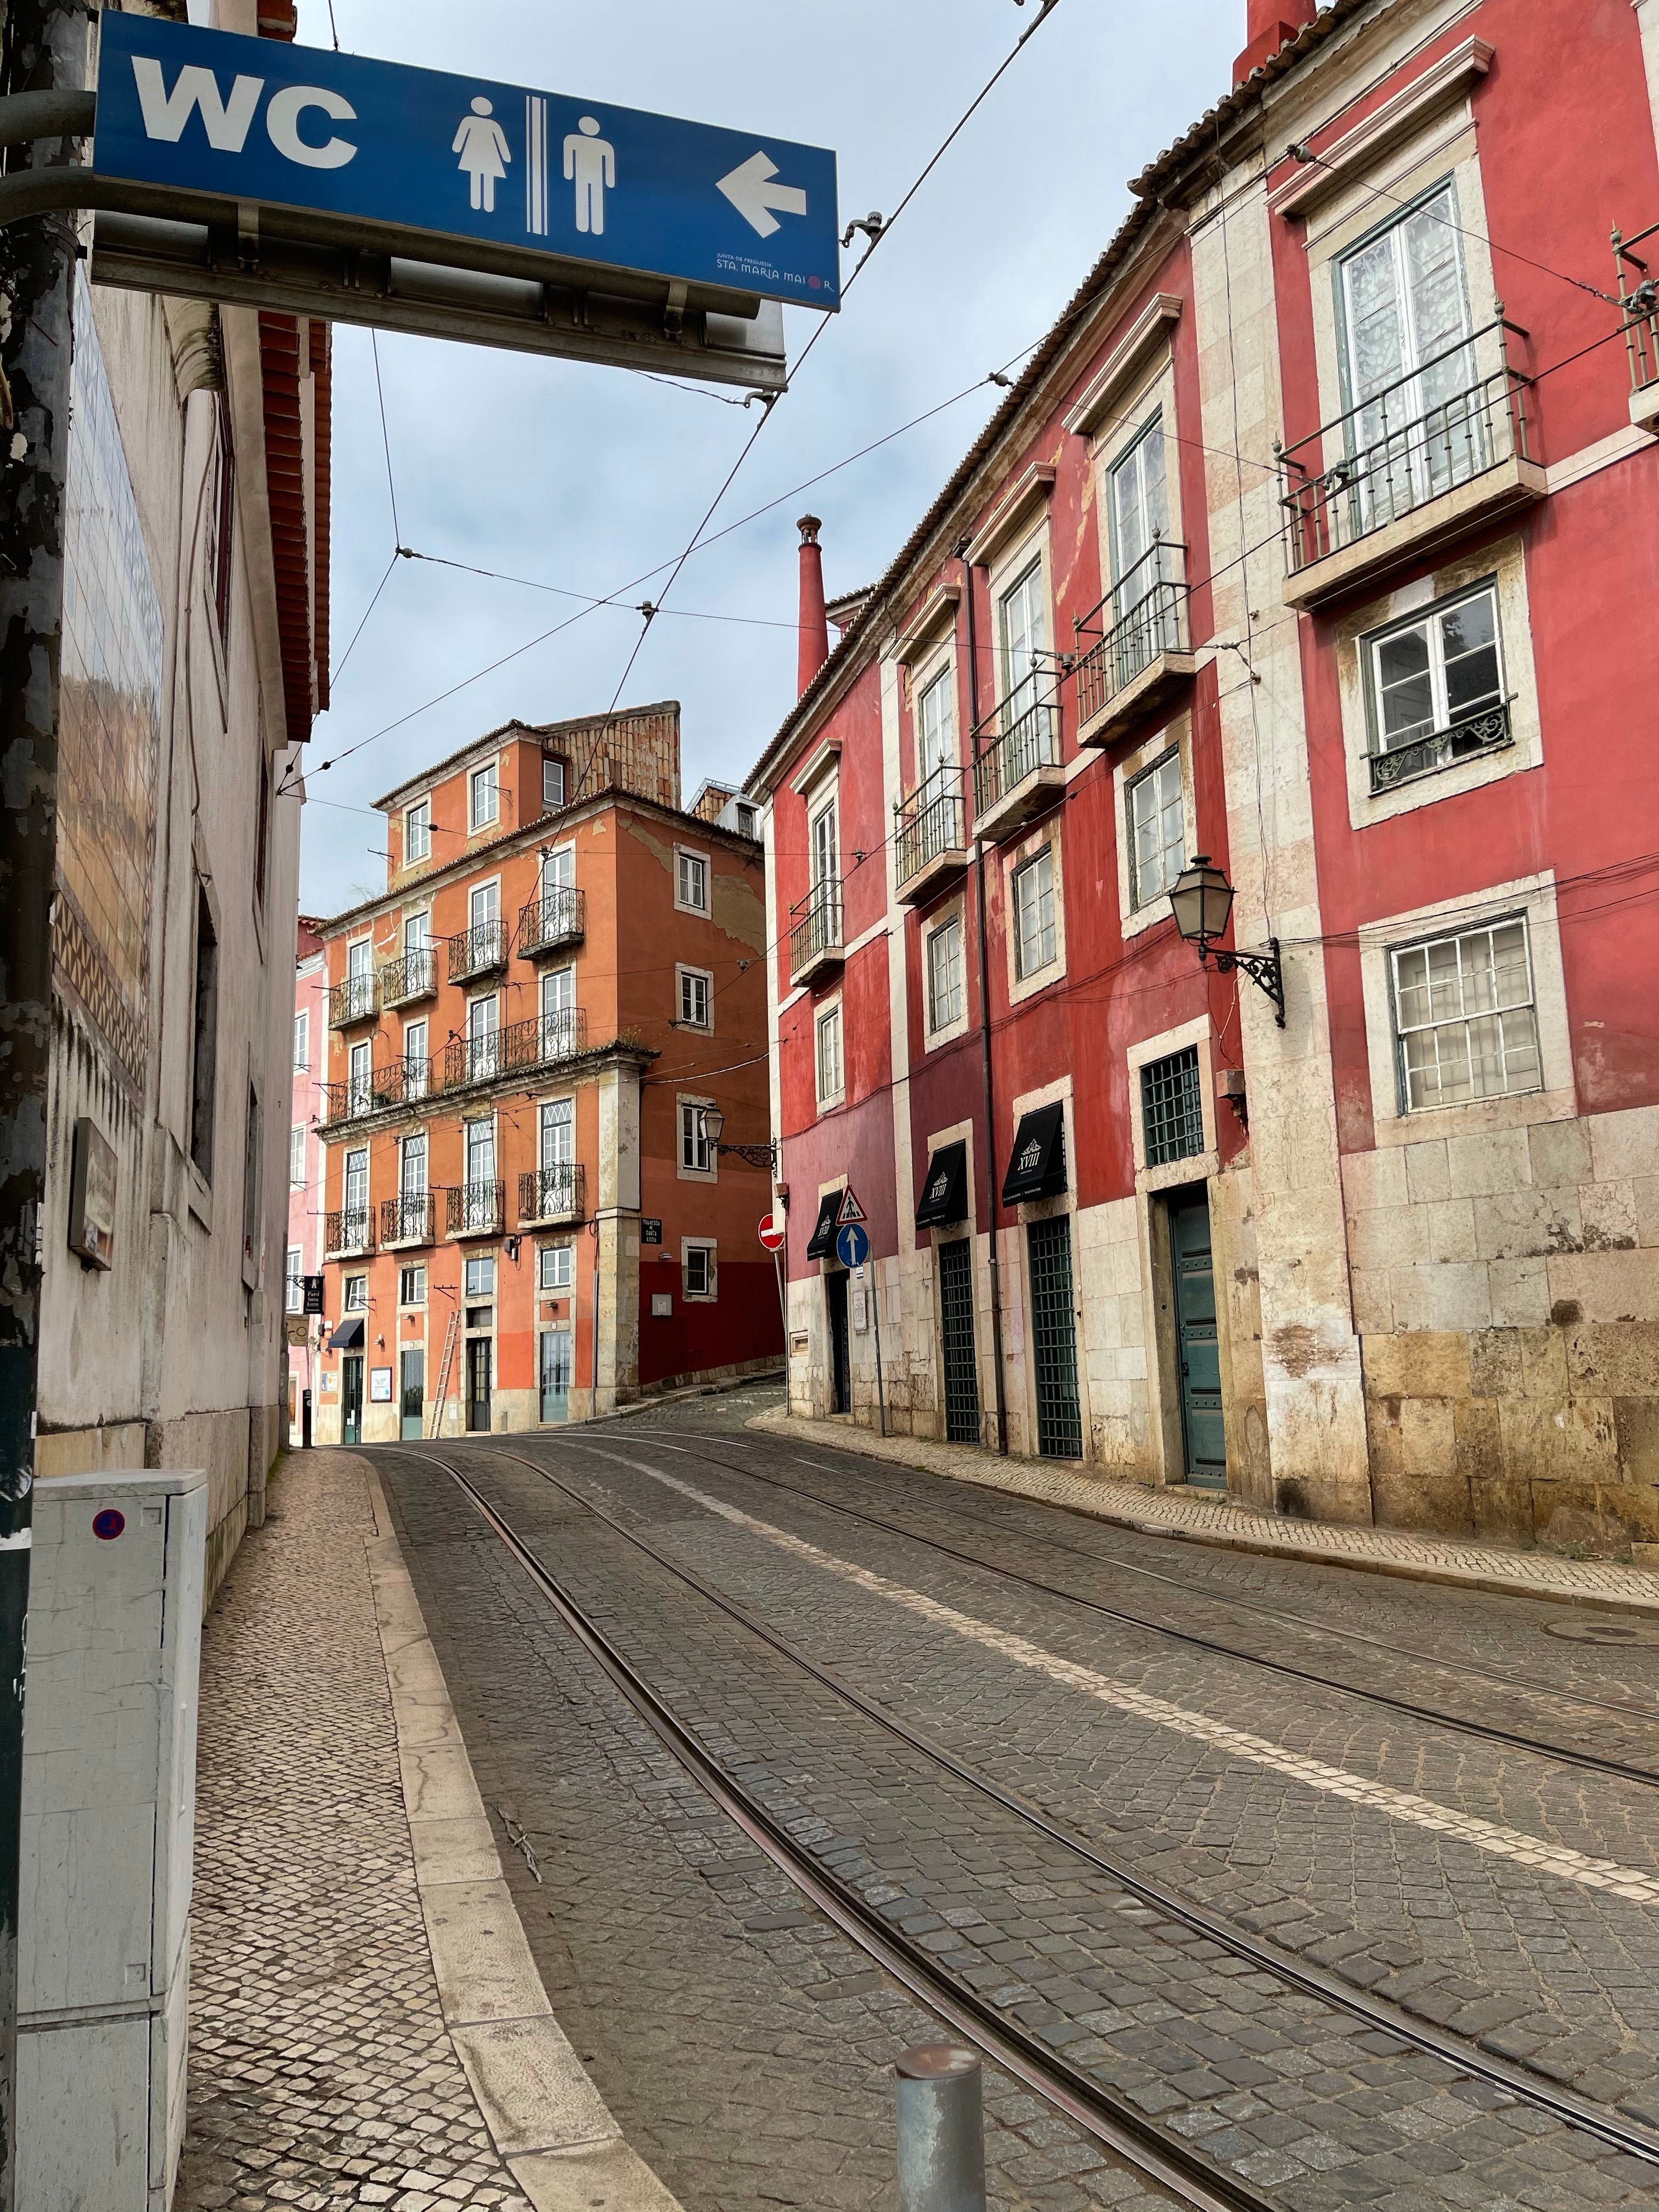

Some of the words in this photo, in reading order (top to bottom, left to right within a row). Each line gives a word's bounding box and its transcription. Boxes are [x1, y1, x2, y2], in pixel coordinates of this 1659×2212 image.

[131, 55, 358, 169] WC
[716, 259, 738, 272] STA.
[741, 264, 779, 279] MARIA
[744, 258, 772, 267] FREGUESIA
[1017, 1152, 1040, 1171] XVIII
[929, 1184, 947, 1199] XVIII
